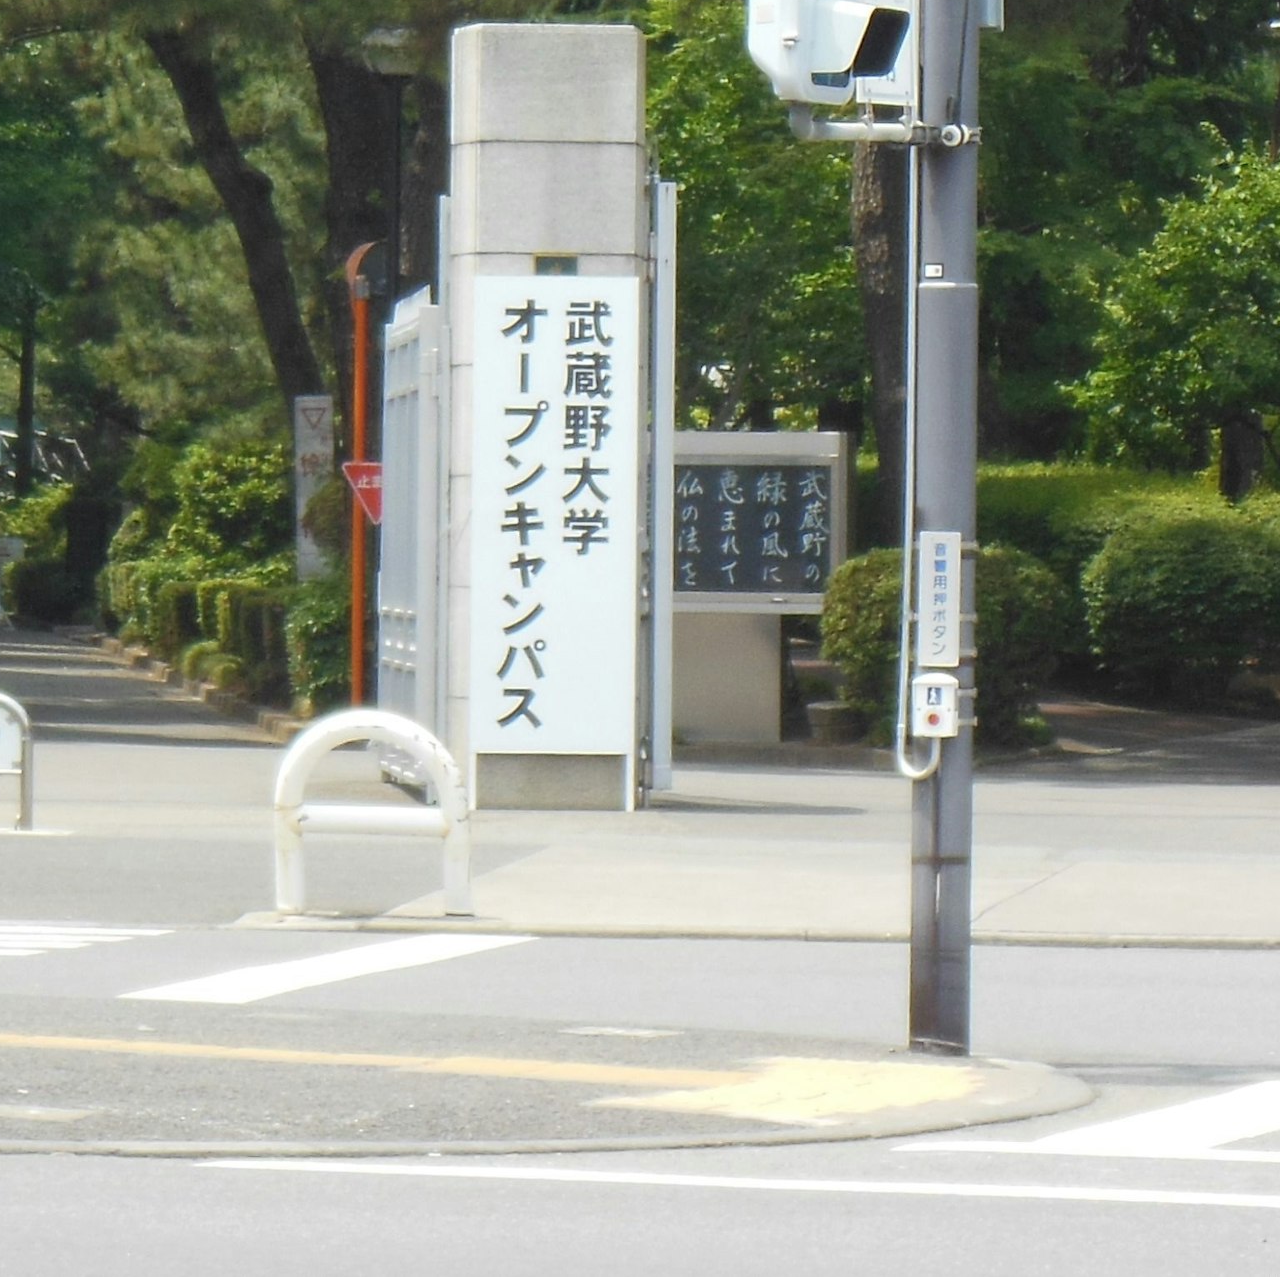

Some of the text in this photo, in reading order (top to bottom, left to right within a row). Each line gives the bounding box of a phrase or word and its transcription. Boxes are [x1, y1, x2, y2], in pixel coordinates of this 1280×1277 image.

[561, 300, 613, 556] 武蔵野大学
[496, 299, 550, 729] オープンキャンパス
[718, 470, 745, 585] 恵まれて
[756, 472, 789, 583] 緑の風に
[798, 470, 830, 583] 武蔵野の
